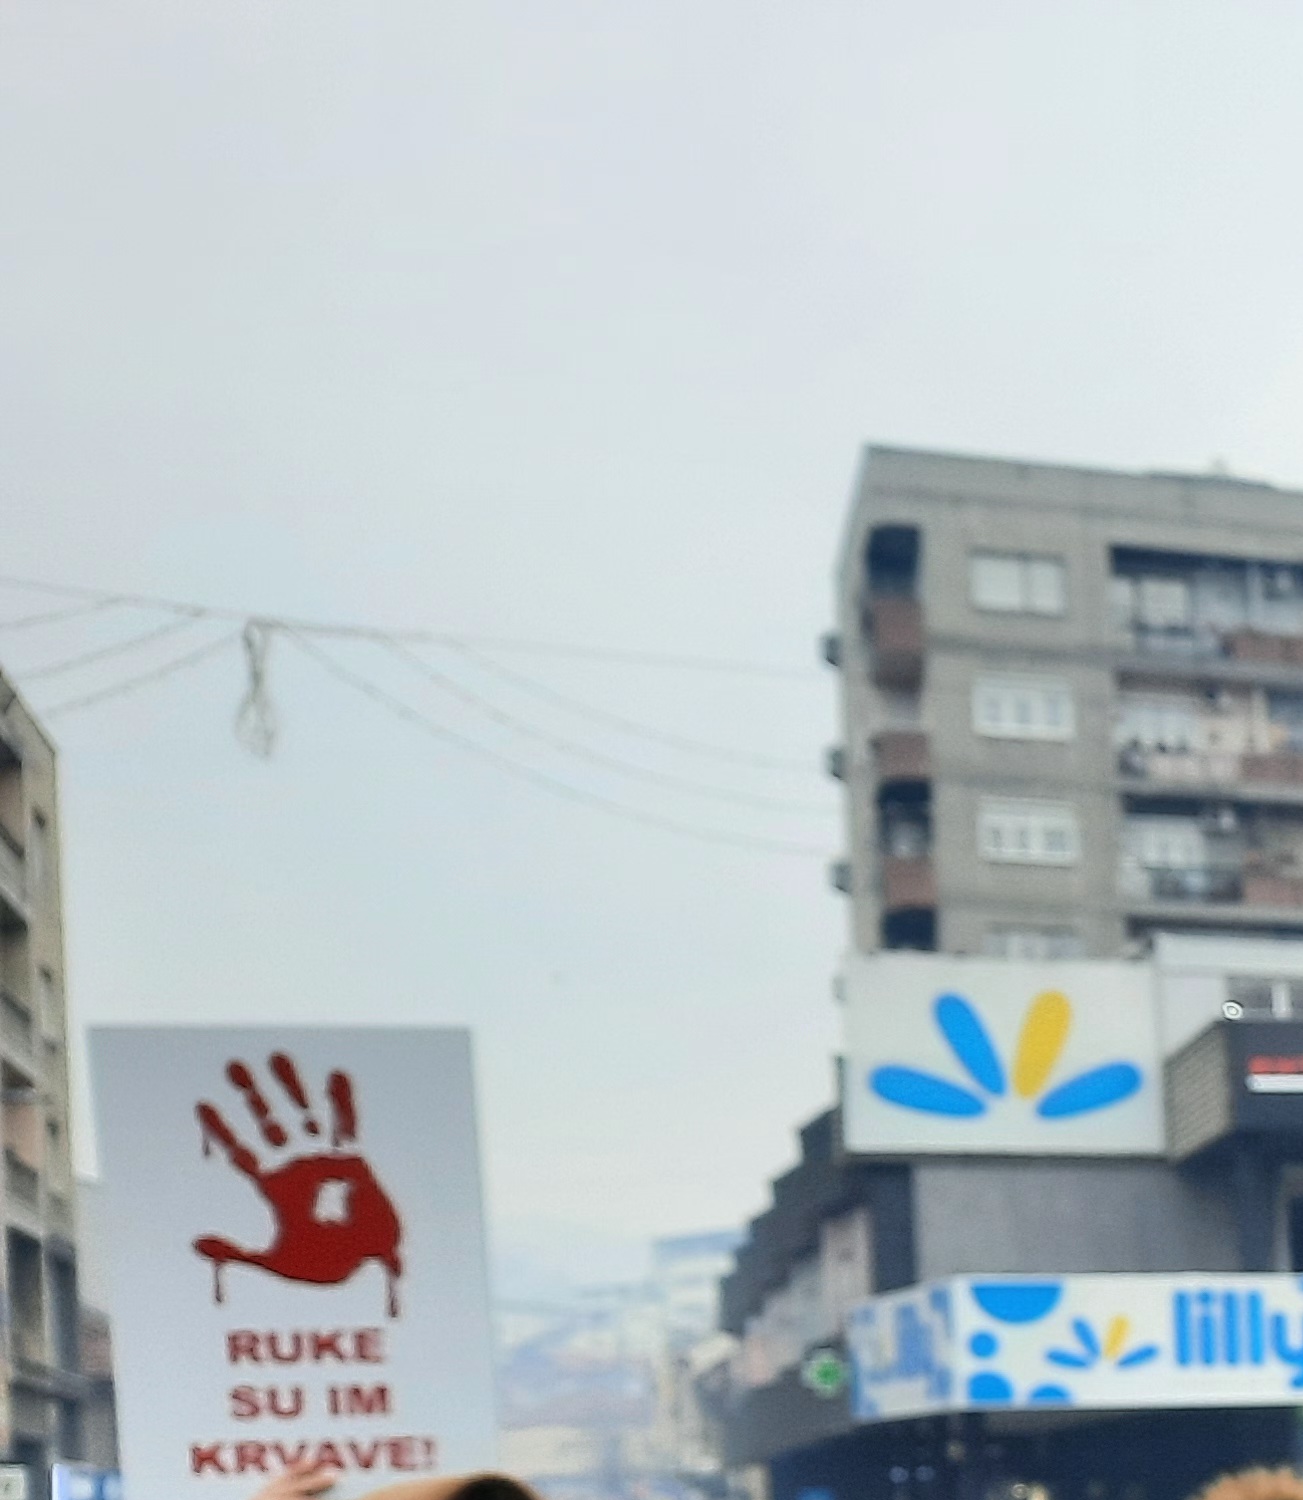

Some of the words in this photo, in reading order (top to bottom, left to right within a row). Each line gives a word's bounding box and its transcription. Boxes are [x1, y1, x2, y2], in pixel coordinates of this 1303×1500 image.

[225, 1329, 385, 1363] RUKE
[229, 1385, 304, 1418] SU
[327, 1384, 392, 1416] IM
[189, 1437, 437, 1475] KRVAVE!
